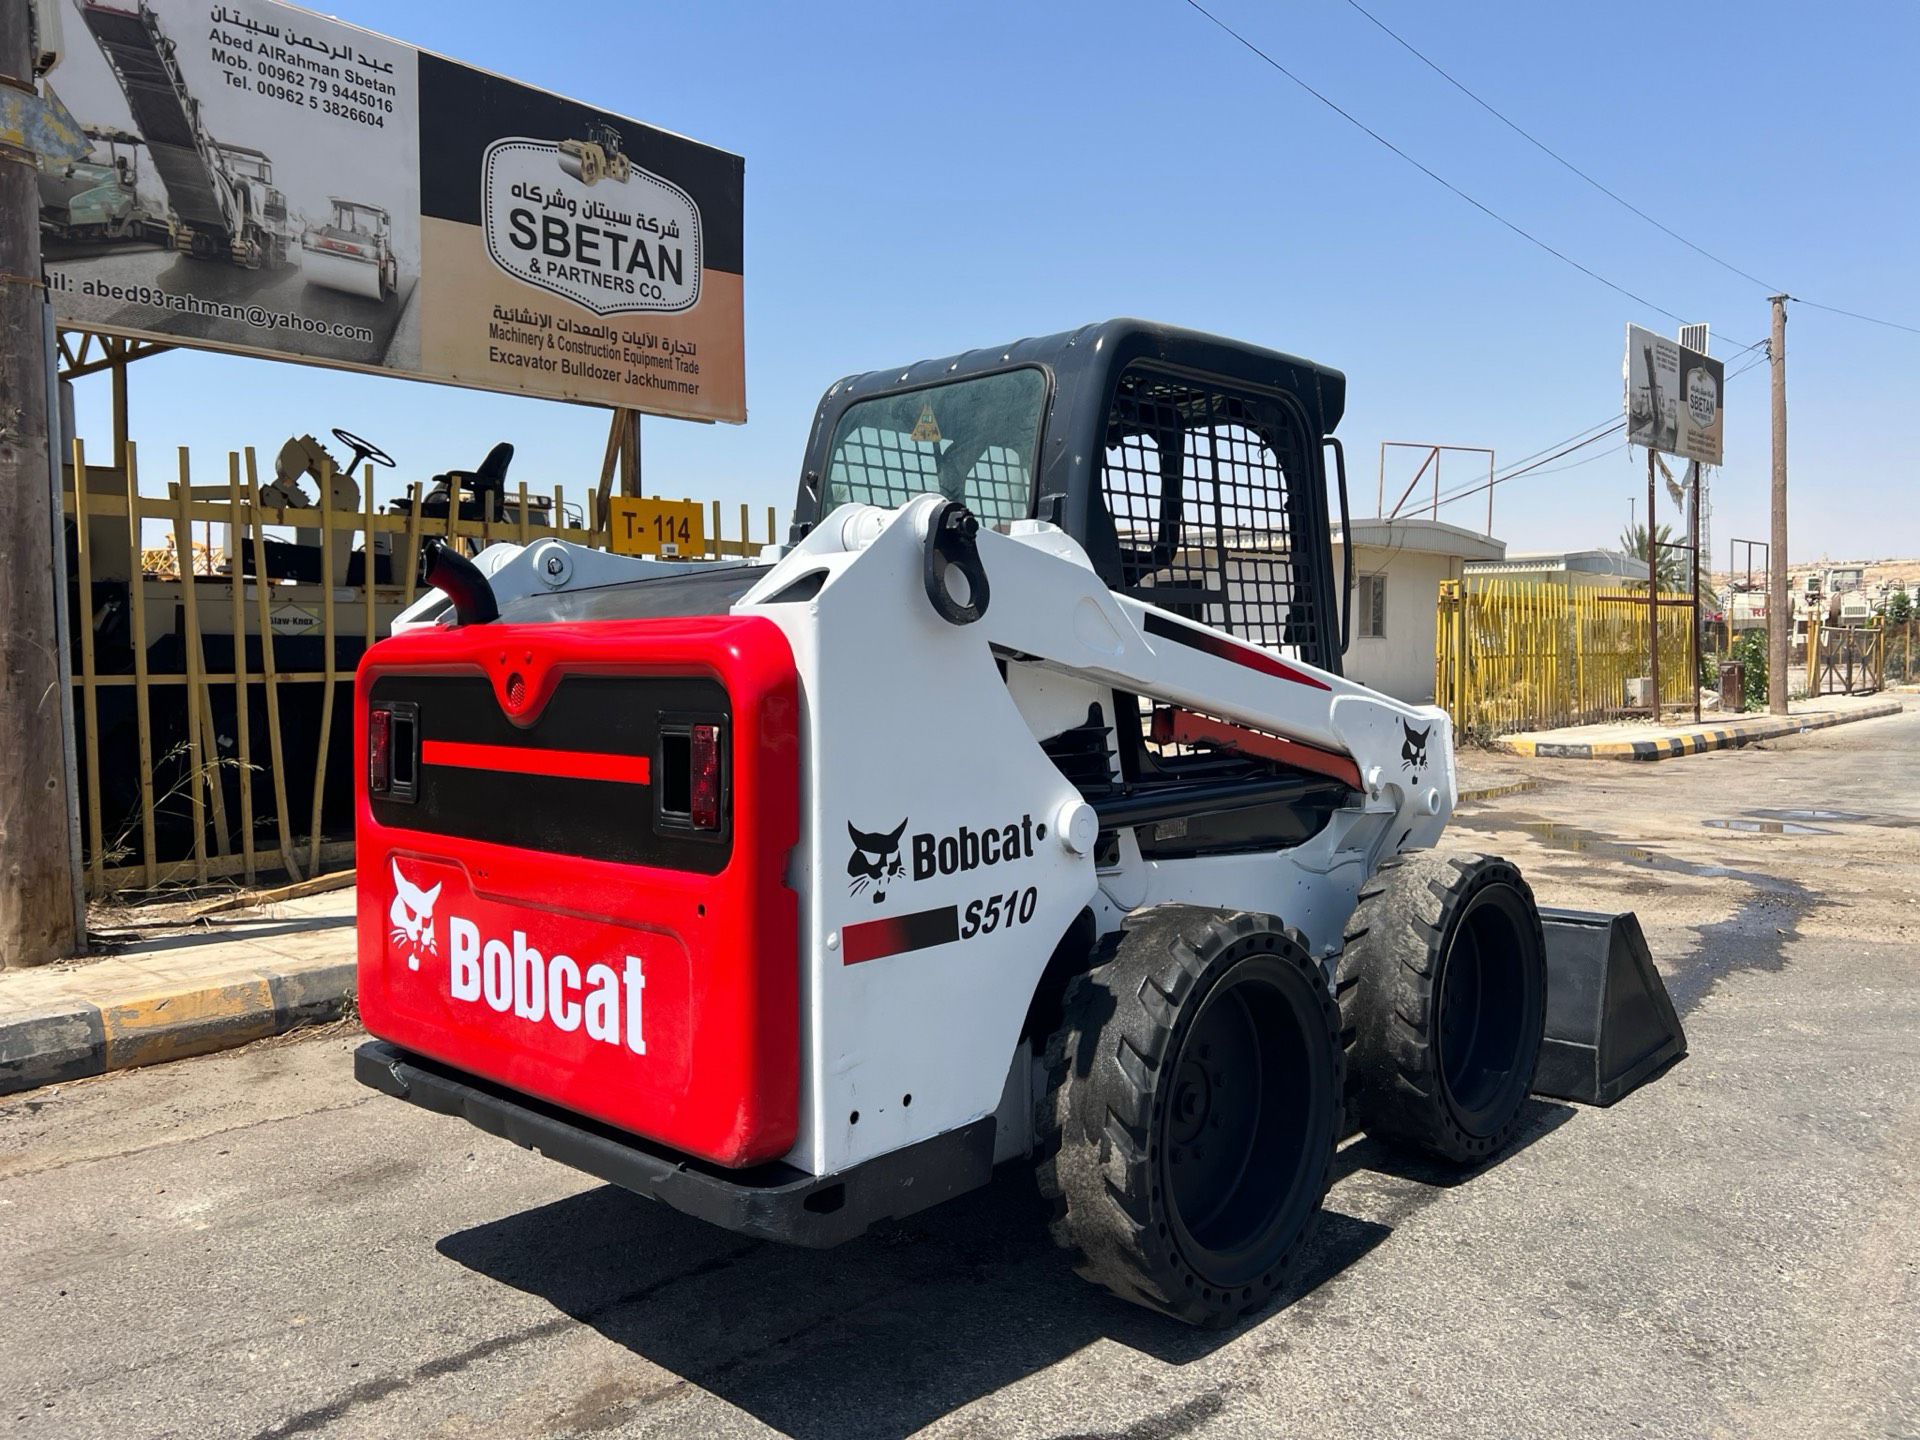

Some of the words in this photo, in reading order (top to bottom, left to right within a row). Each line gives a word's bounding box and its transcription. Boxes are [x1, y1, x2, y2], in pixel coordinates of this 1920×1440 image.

[210, 4, 279, 38] سبيتان
[209, 28, 253, 52] Abed
[257, 43, 339, 79] AlRahman
[344, 69, 396, 96] Sbetan
[284, 28, 352, 61] الرحمن
[357, 53, 394, 74] عبد
[211, 47, 252, 72] Mob.
[257, 61, 305, 87] 00962
[309, 76, 327, 93] 79
[332, 84, 393, 113] 9445016
[222, 69, 252, 91] Tel.
[257, 80, 304, 106] 00962
[309, 96, 318, 109] 5
[322, 99, 384, 128] 3826604
[511, 182, 577, 217] وشركاه
[582, 199, 631, 227] سبيتان
[509, 207, 683, 286] SBETAN
[636, 212, 680, 240] شركة
[529, 258, 541, 274] &
[546, 261, 635, 294] PARTNERS
[639, 282, 666, 302] CO.
[82, 279, 373, 343] abed93rahman@yahoo.com
[556, 318, 618, 345] والمعدات
[489, 322, 544, 350] Machinery
[547, 333, 555, 349] &
[557, 335, 621, 360] Construction
[624, 347, 673, 370] Equipment
[675, 356, 699, 375] Trade
[662, 337, 696, 357] لتجارة
[490, 346, 557, 372] Excavator
[561, 358, 622, 383] Bulldozer
[624, 370, 699, 395] Jackhummer
[1690, 393, 1715, 416] SBETAN
[912, 813, 1034, 881] Bobcat
[961, 886, 1038, 939] S510
[450, 916, 646, 1055] Bobcat
